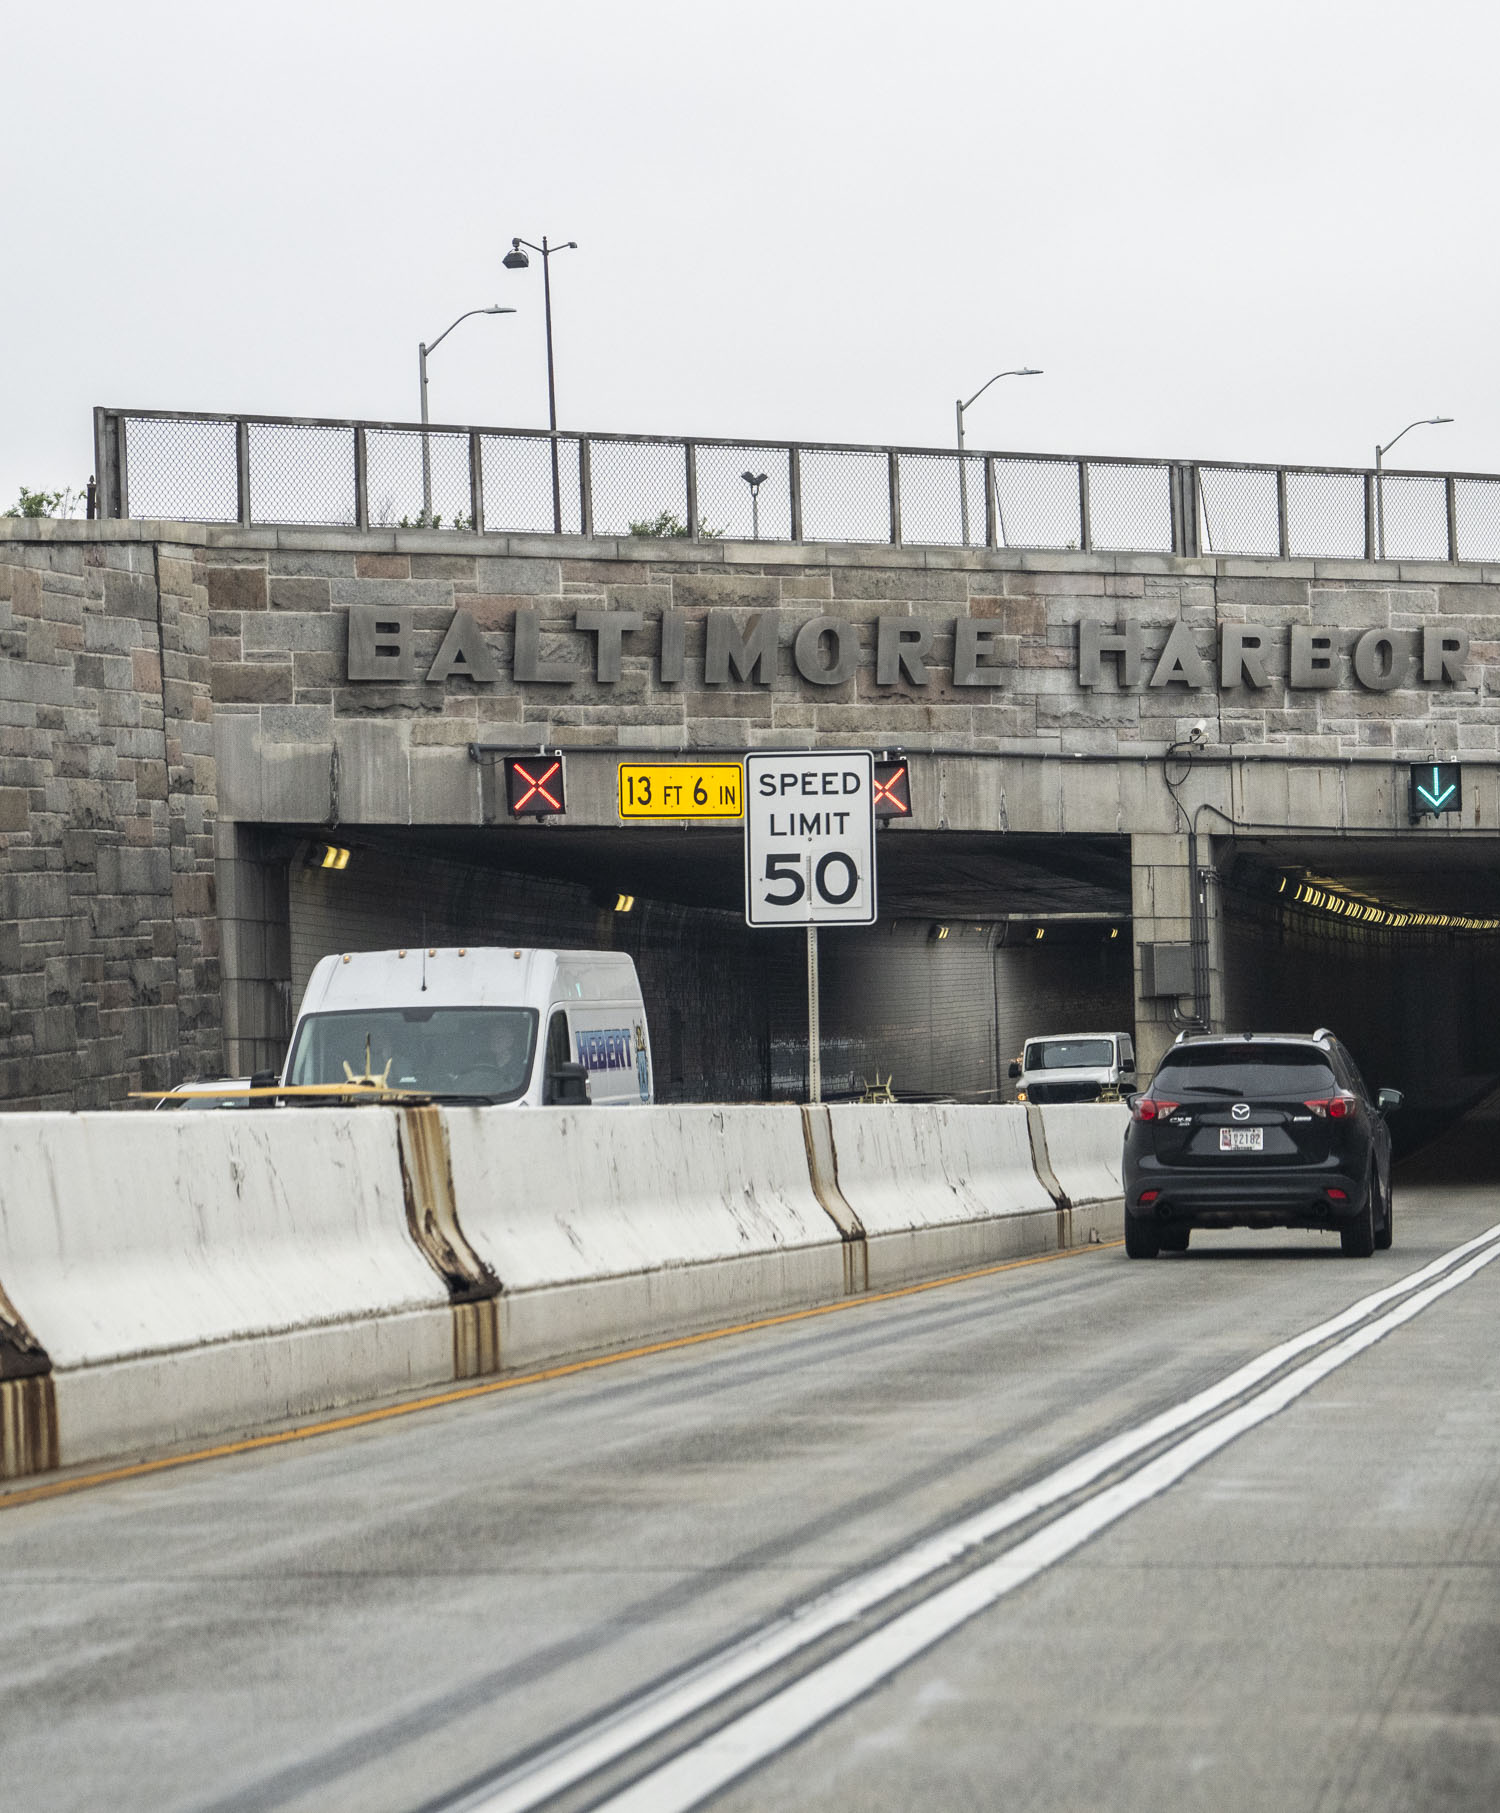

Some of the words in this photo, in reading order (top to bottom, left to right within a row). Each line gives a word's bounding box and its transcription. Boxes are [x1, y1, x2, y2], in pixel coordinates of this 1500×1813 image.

[348, 605, 1010, 686] BALTIMORE
[1076, 619, 1469, 691] HARBOR
[627, 776, 652, 806] 13
[664, 786, 683, 805] FT
[693, 776, 708, 806] 6
[719, 785, 735, 806] IN
[759, 772, 861, 797] SPEED
[770, 812, 850, 836] LIMIT
[764, 851, 858, 906] 50
[575, 1029, 632, 1070] HEBERT
